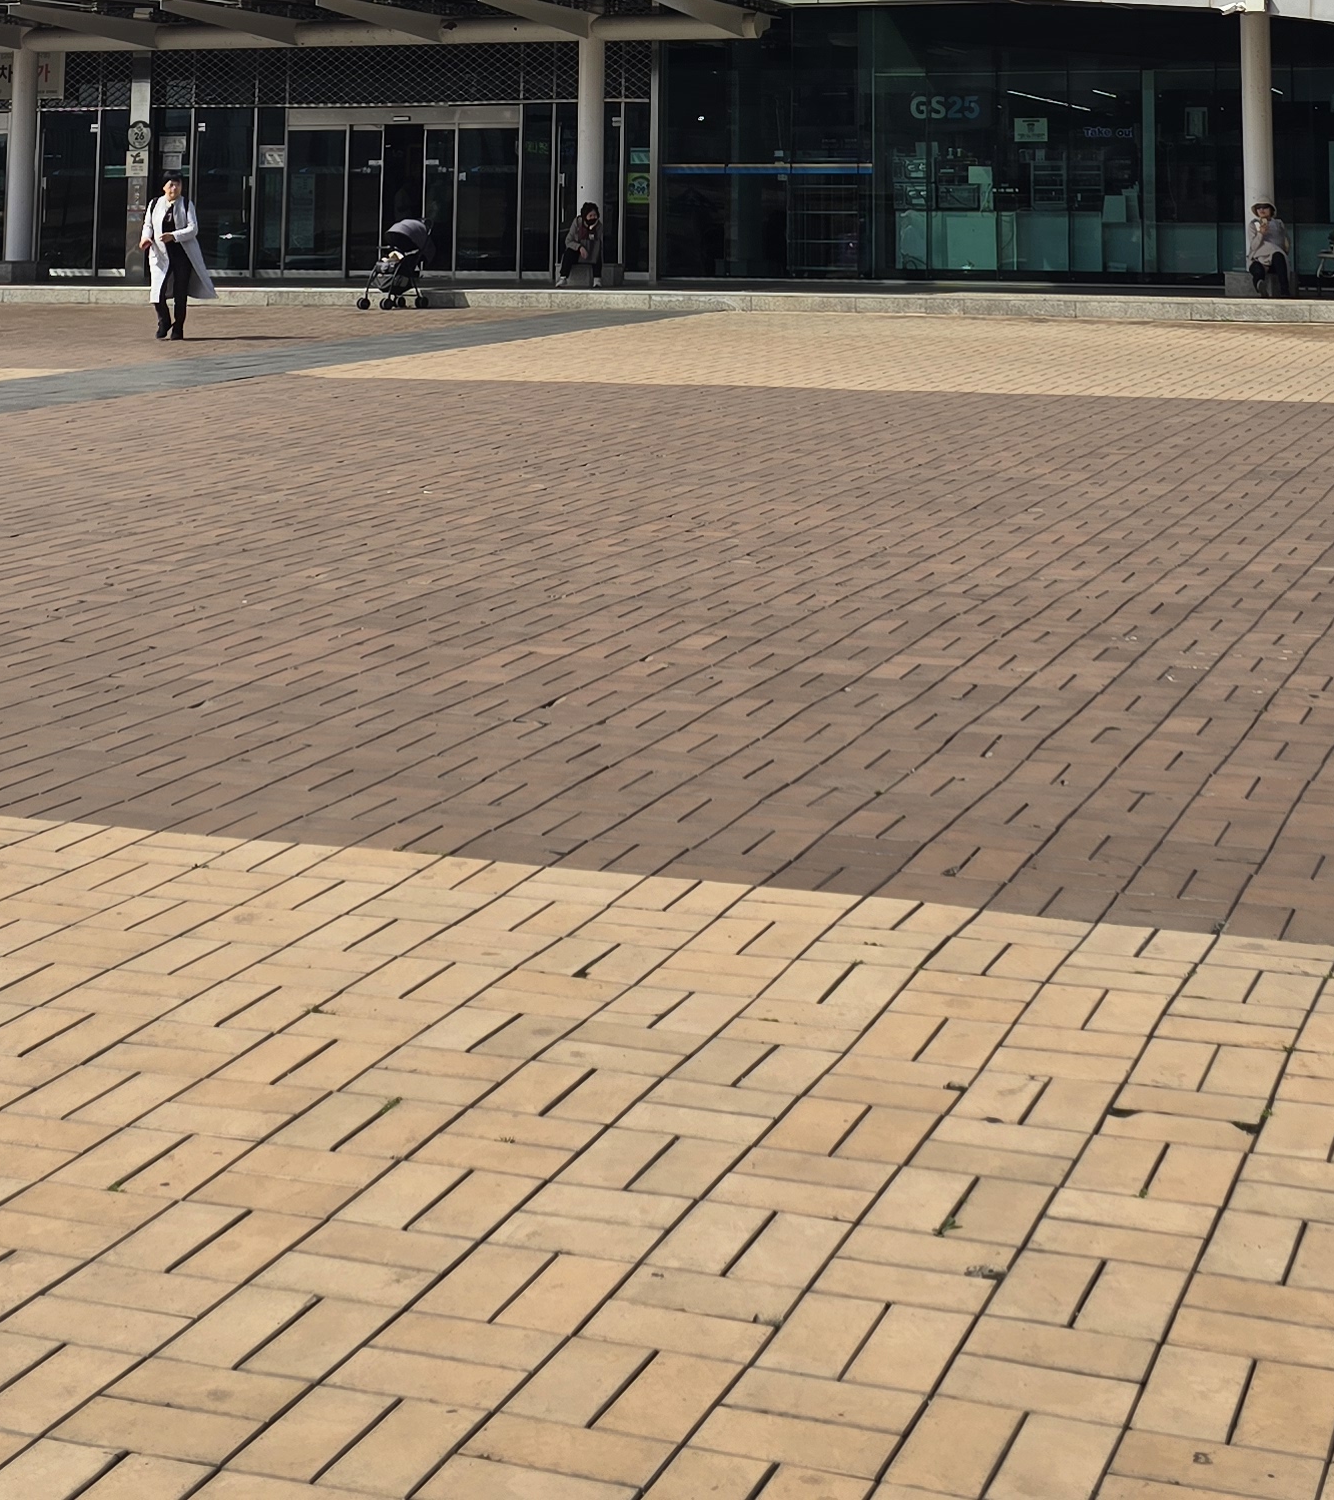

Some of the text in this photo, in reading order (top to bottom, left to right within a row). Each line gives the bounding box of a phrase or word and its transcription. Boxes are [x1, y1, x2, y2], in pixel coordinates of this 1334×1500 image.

[910, 95, 981, 119] GS25
[134, 132, 145, 140] 26
[1083, 126, 1112, 138] Take
